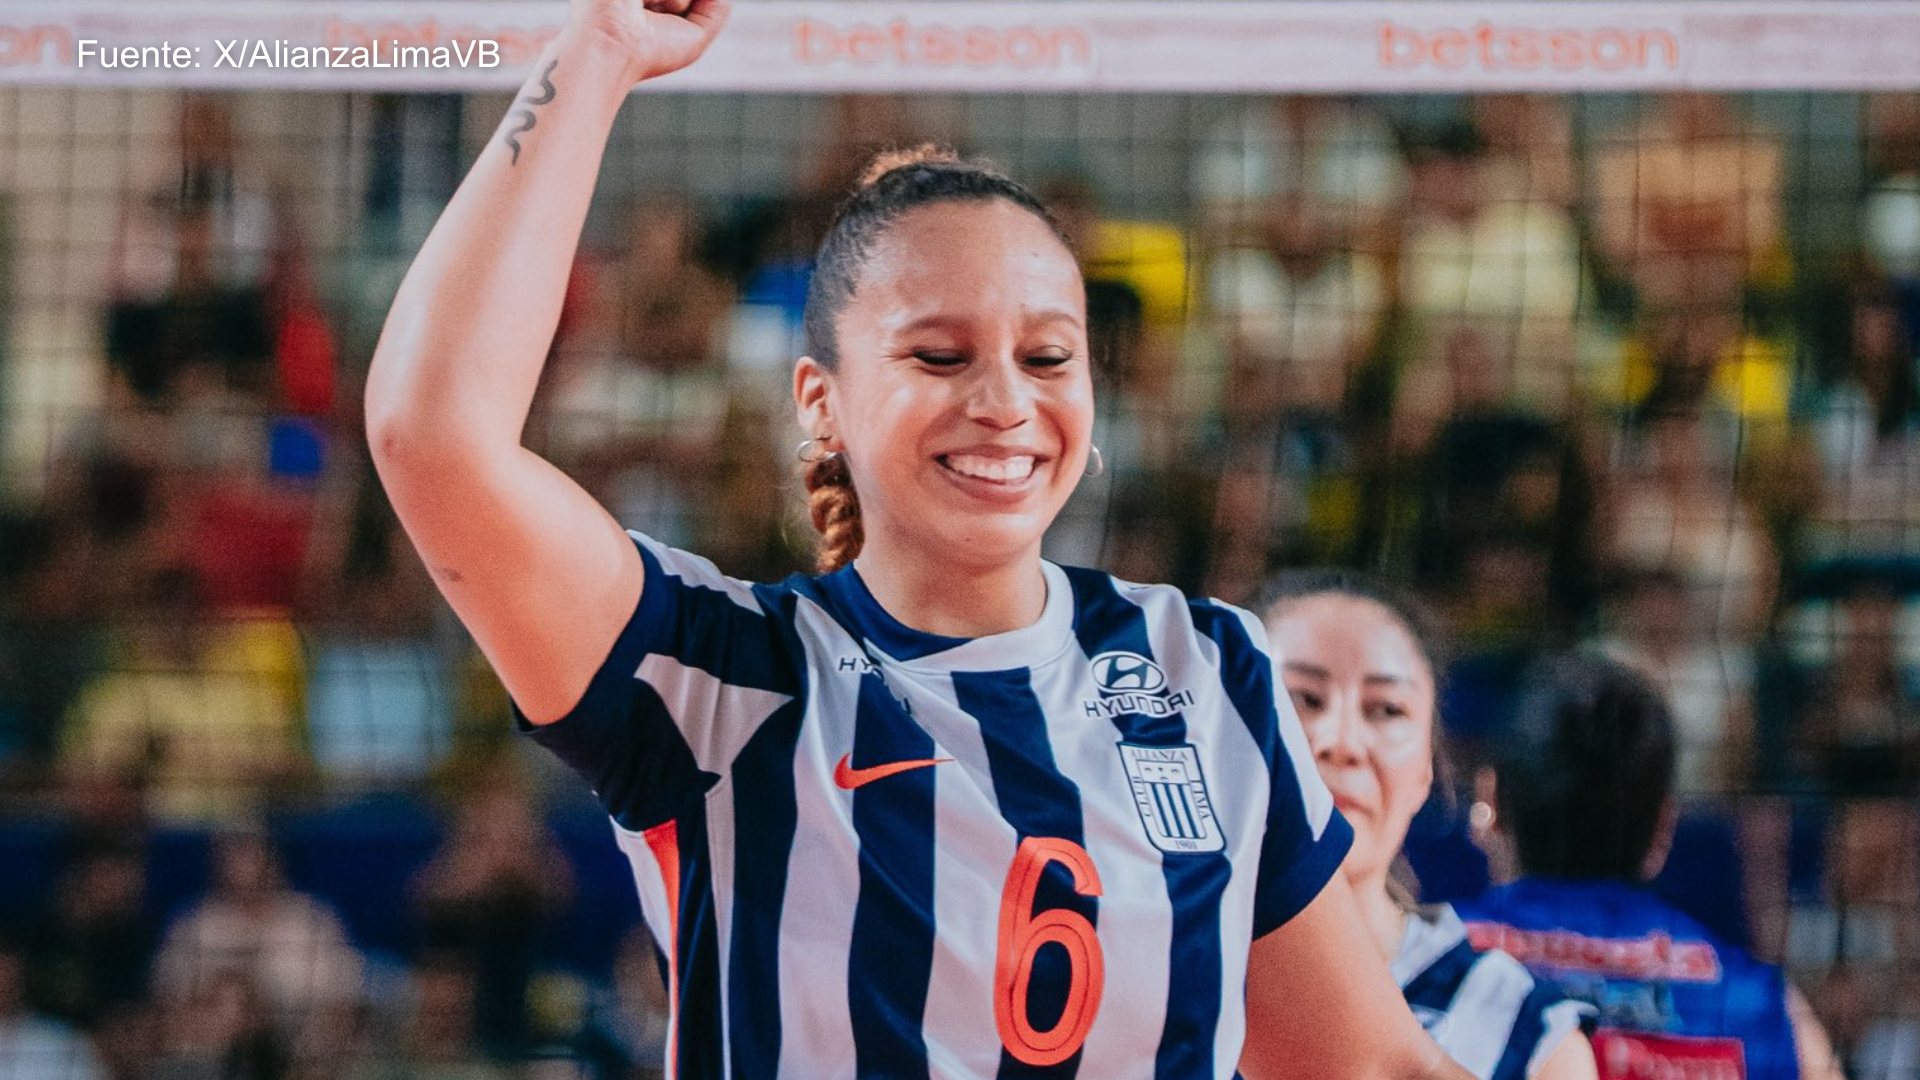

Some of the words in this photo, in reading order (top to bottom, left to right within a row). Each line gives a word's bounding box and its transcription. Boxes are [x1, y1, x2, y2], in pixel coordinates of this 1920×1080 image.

[794, 20, 1091, 67] betsson
[1378, 20, 1679, 70] betsson
[1084, 690, 1195, 717] HYUNDAI
[1130, 749, 1188, 761] ALIANZA
[1190, 779, 1211, 819] LIMA
[993, 836, 1105, 1066] 6
